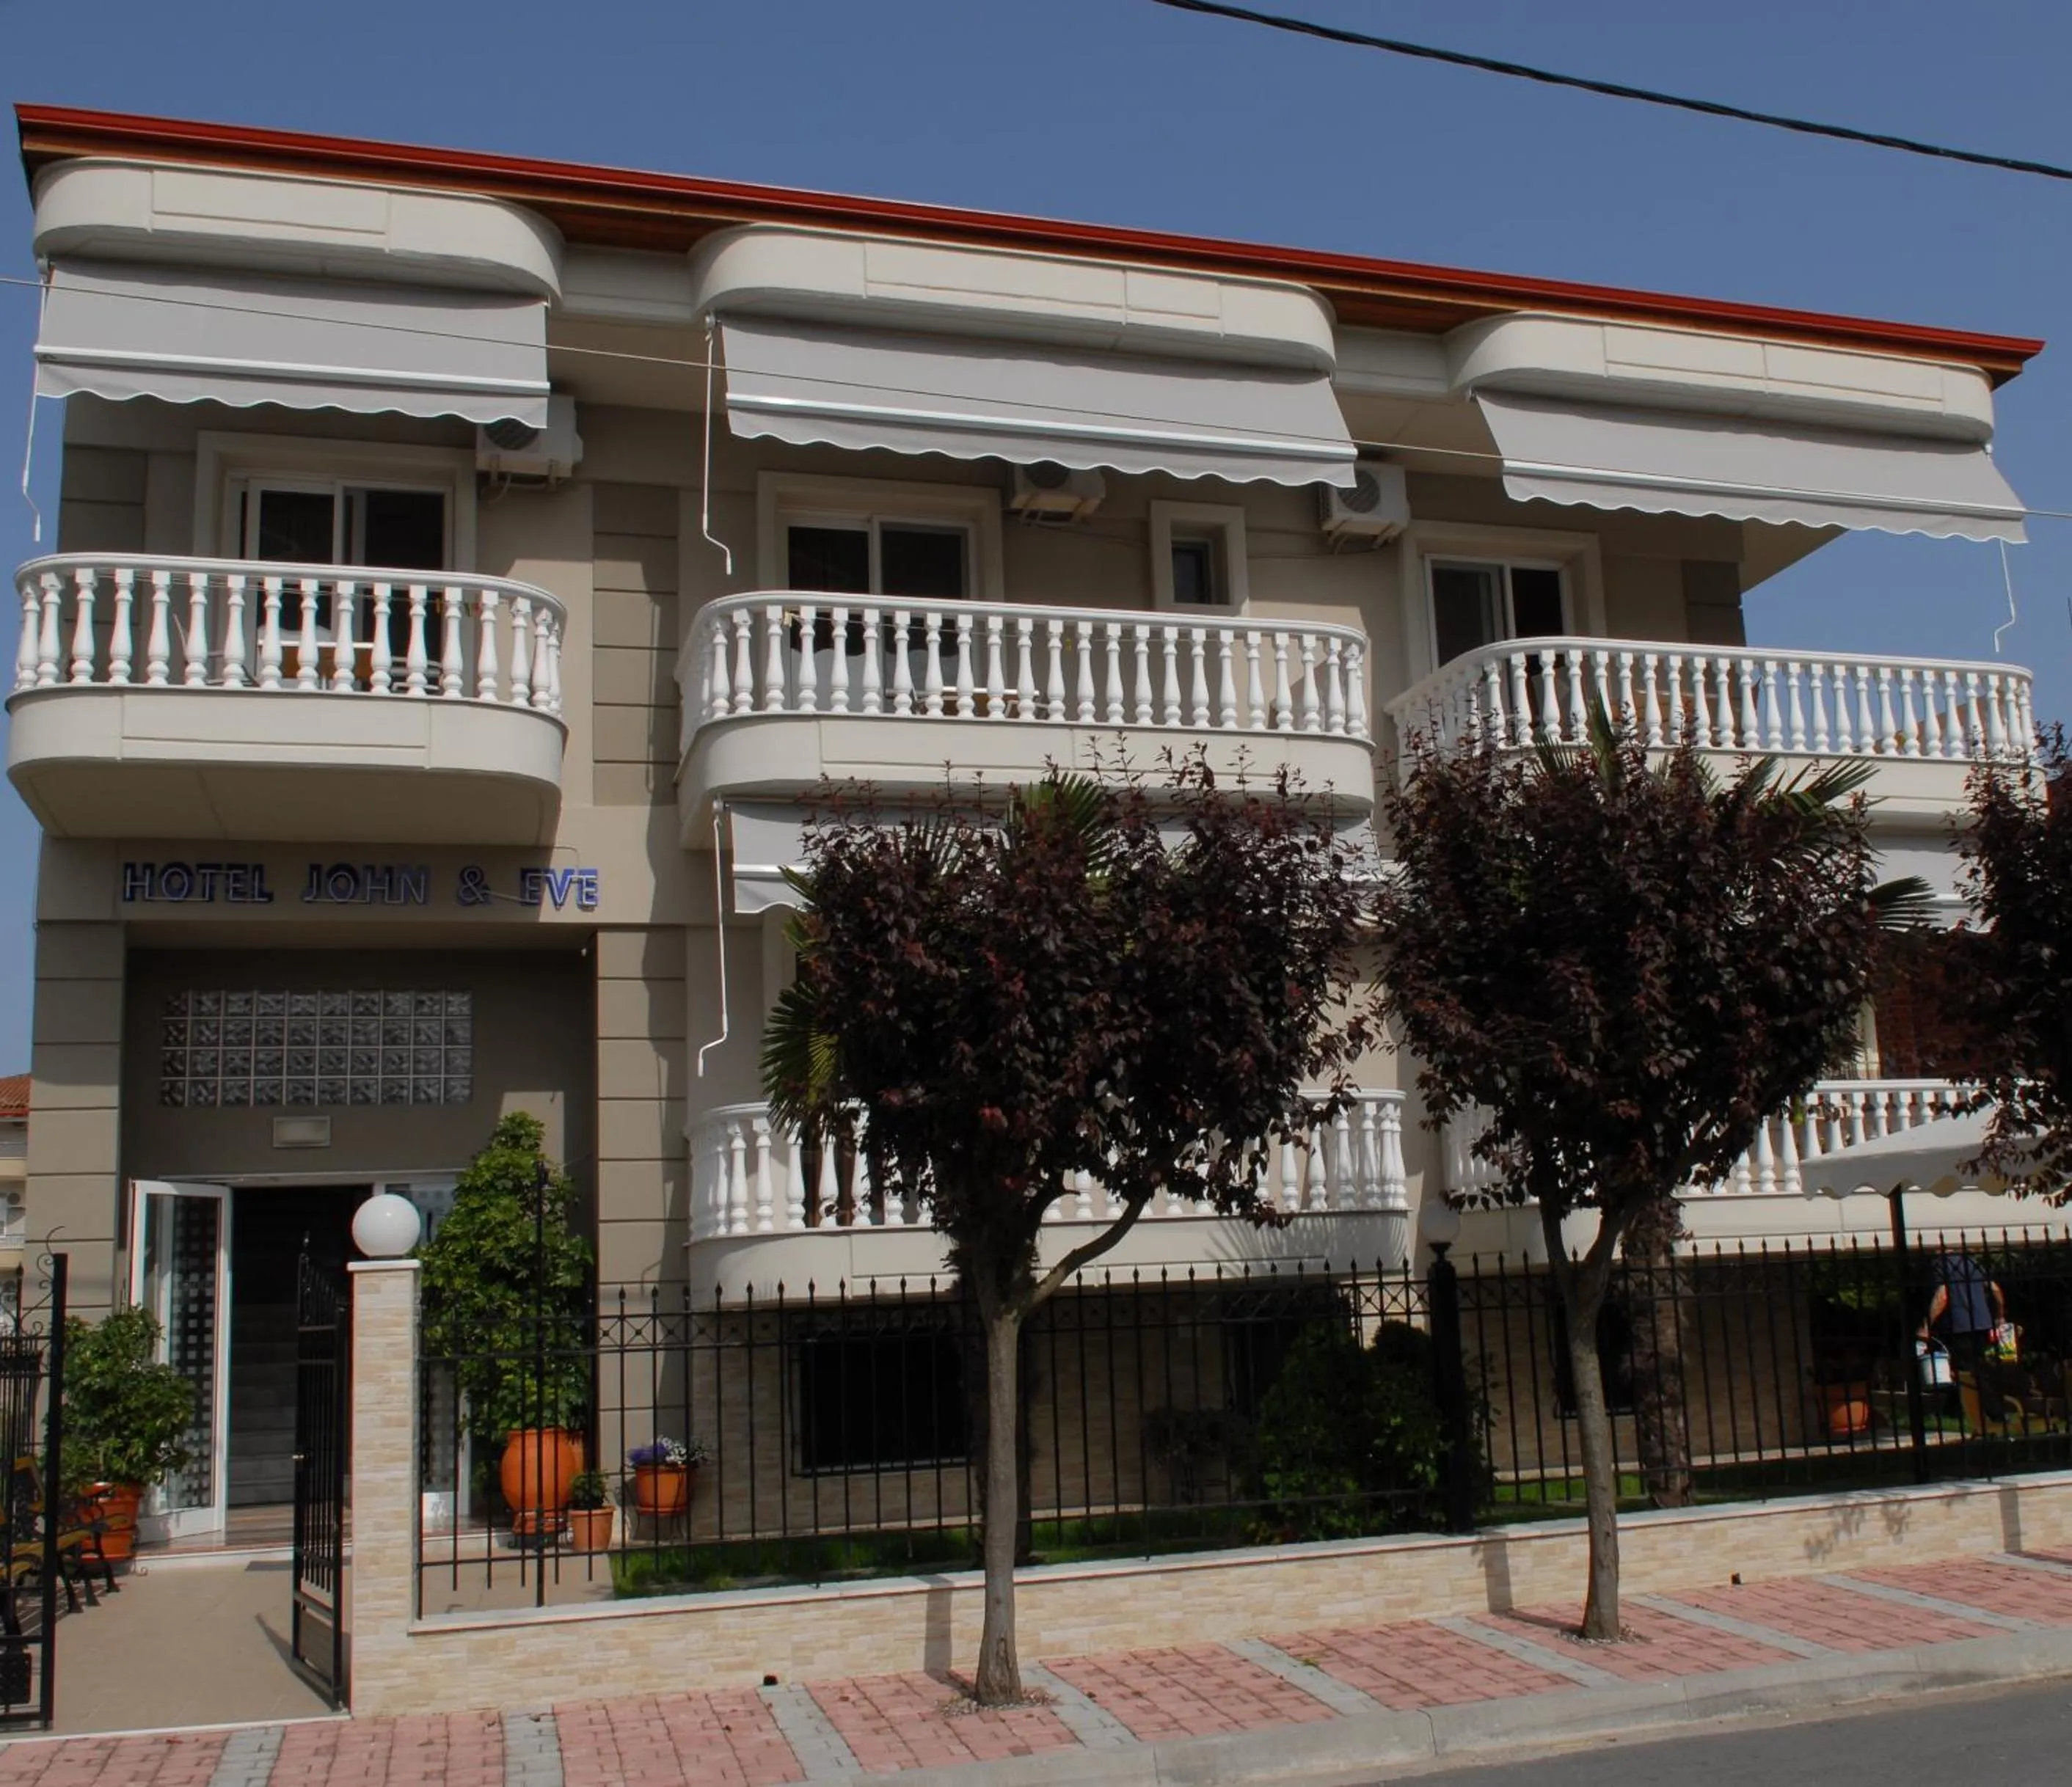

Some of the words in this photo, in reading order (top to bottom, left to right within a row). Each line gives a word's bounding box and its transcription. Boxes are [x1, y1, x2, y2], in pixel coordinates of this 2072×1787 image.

[123, 862, 274, 903] HOTEL
[301, 863, 430, 905] JOHN
[457, 866, 491, 906] &
[519, 869, 599, 910] EVE
